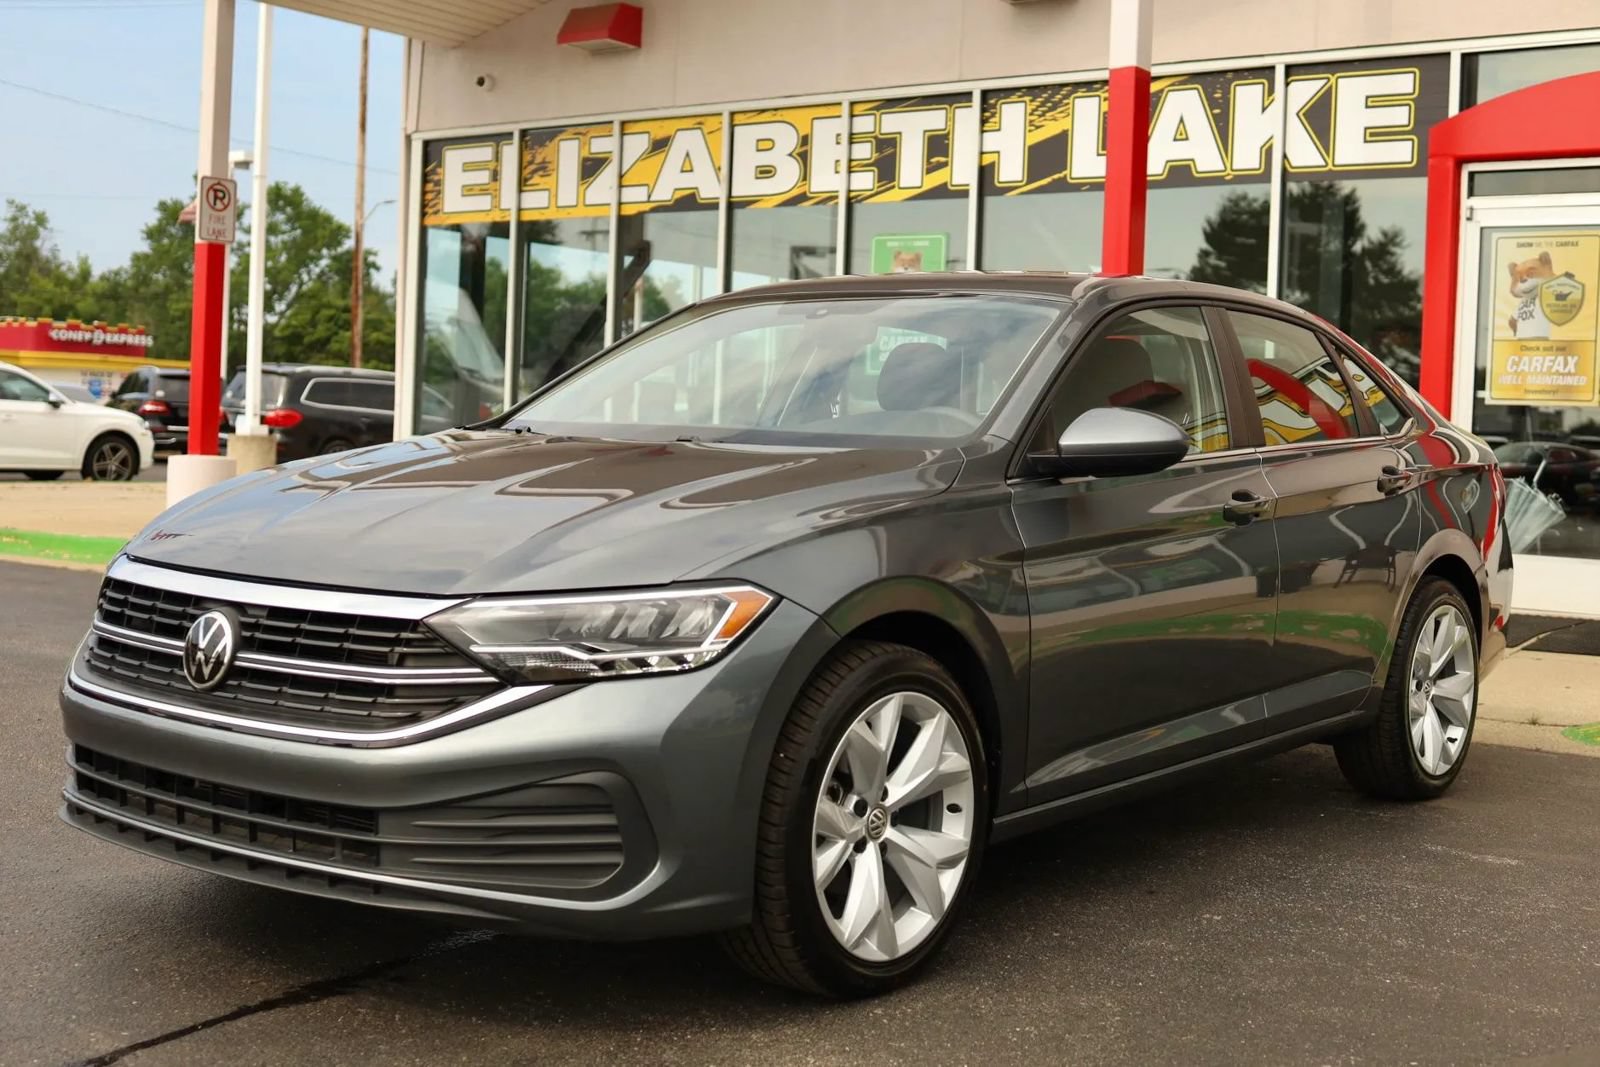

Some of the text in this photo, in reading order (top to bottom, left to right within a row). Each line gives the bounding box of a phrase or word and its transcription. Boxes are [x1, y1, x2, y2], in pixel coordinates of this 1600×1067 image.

[441, 68, 1419, 214] ELIZABETH LAKE
[207, 227, 226, 239] LANE
[105, 333, 154, 347] EXPRESS
[1506, 355, 1579, 373] CARFAX
[1499, 374, 1588, 386] WELL MAINTAINED
